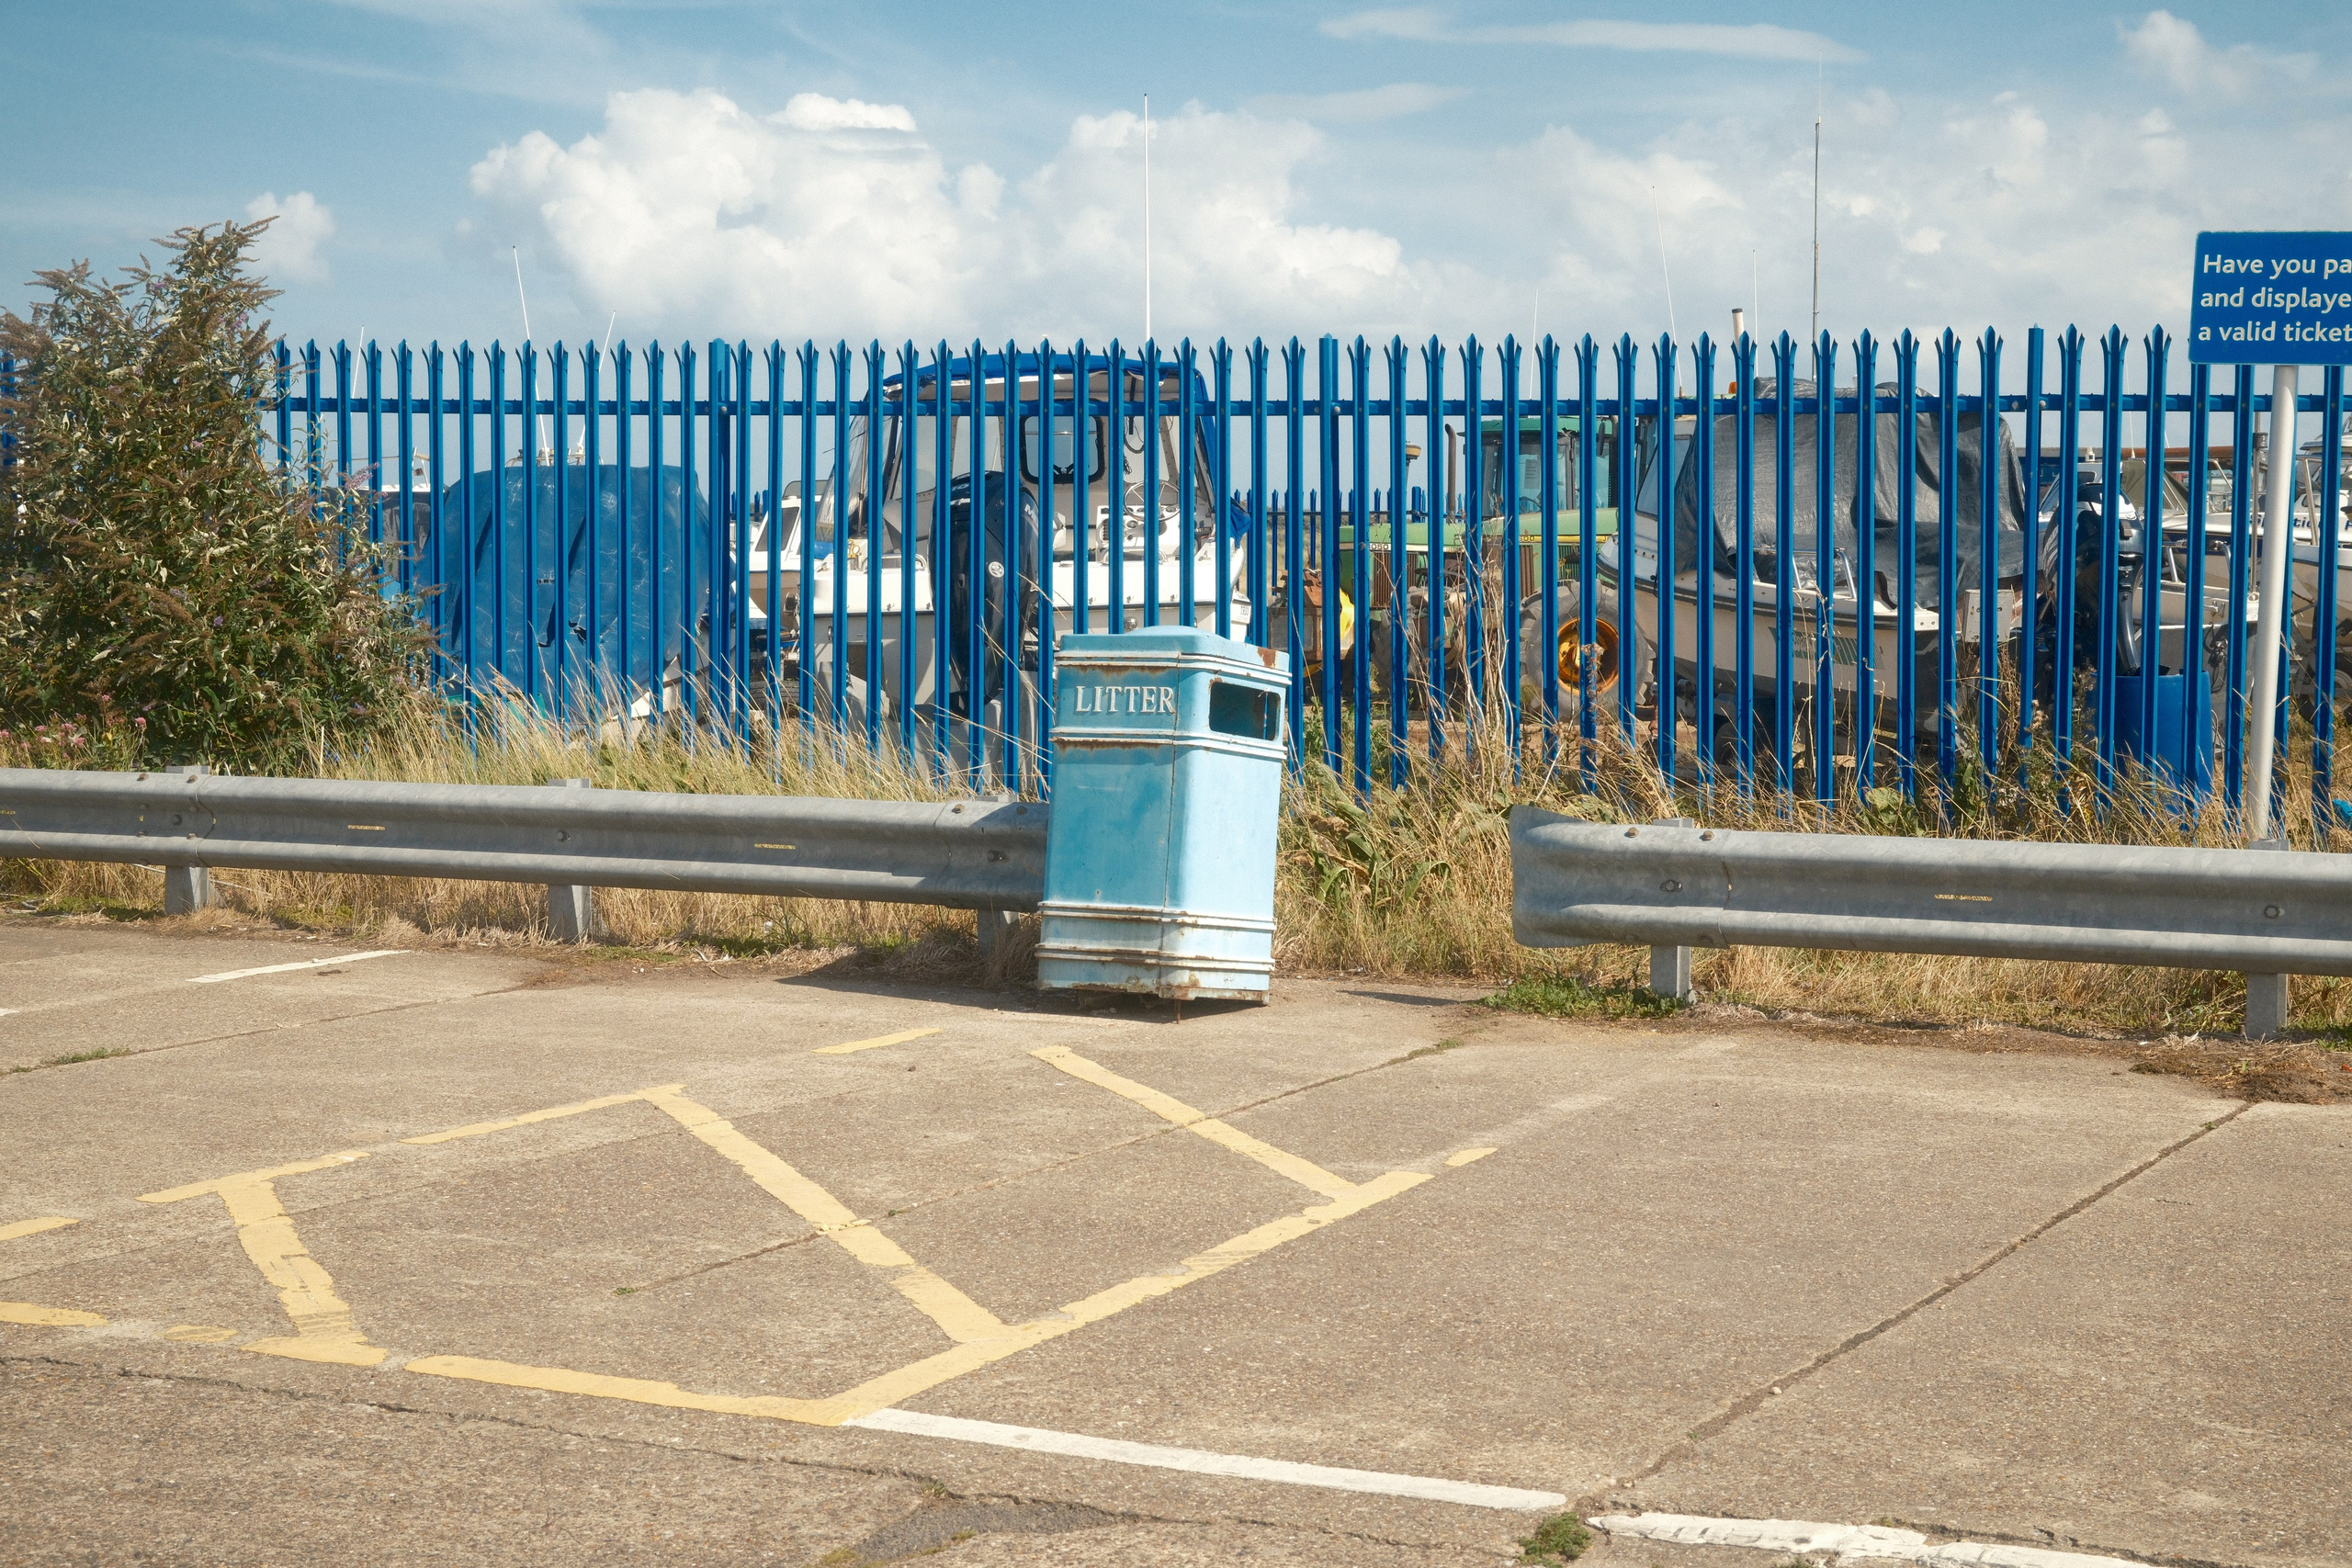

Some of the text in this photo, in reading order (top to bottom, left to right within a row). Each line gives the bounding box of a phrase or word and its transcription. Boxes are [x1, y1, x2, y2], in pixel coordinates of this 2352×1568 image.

[2203, 254, 2264, 274] Have
[2269, 259, 2316, 279] you
[2200, 287, 2352, 314] and displaye
[2198, 321, 2352, 342] a valid ticket
[1075, 685, 1176, 714] LITTER
